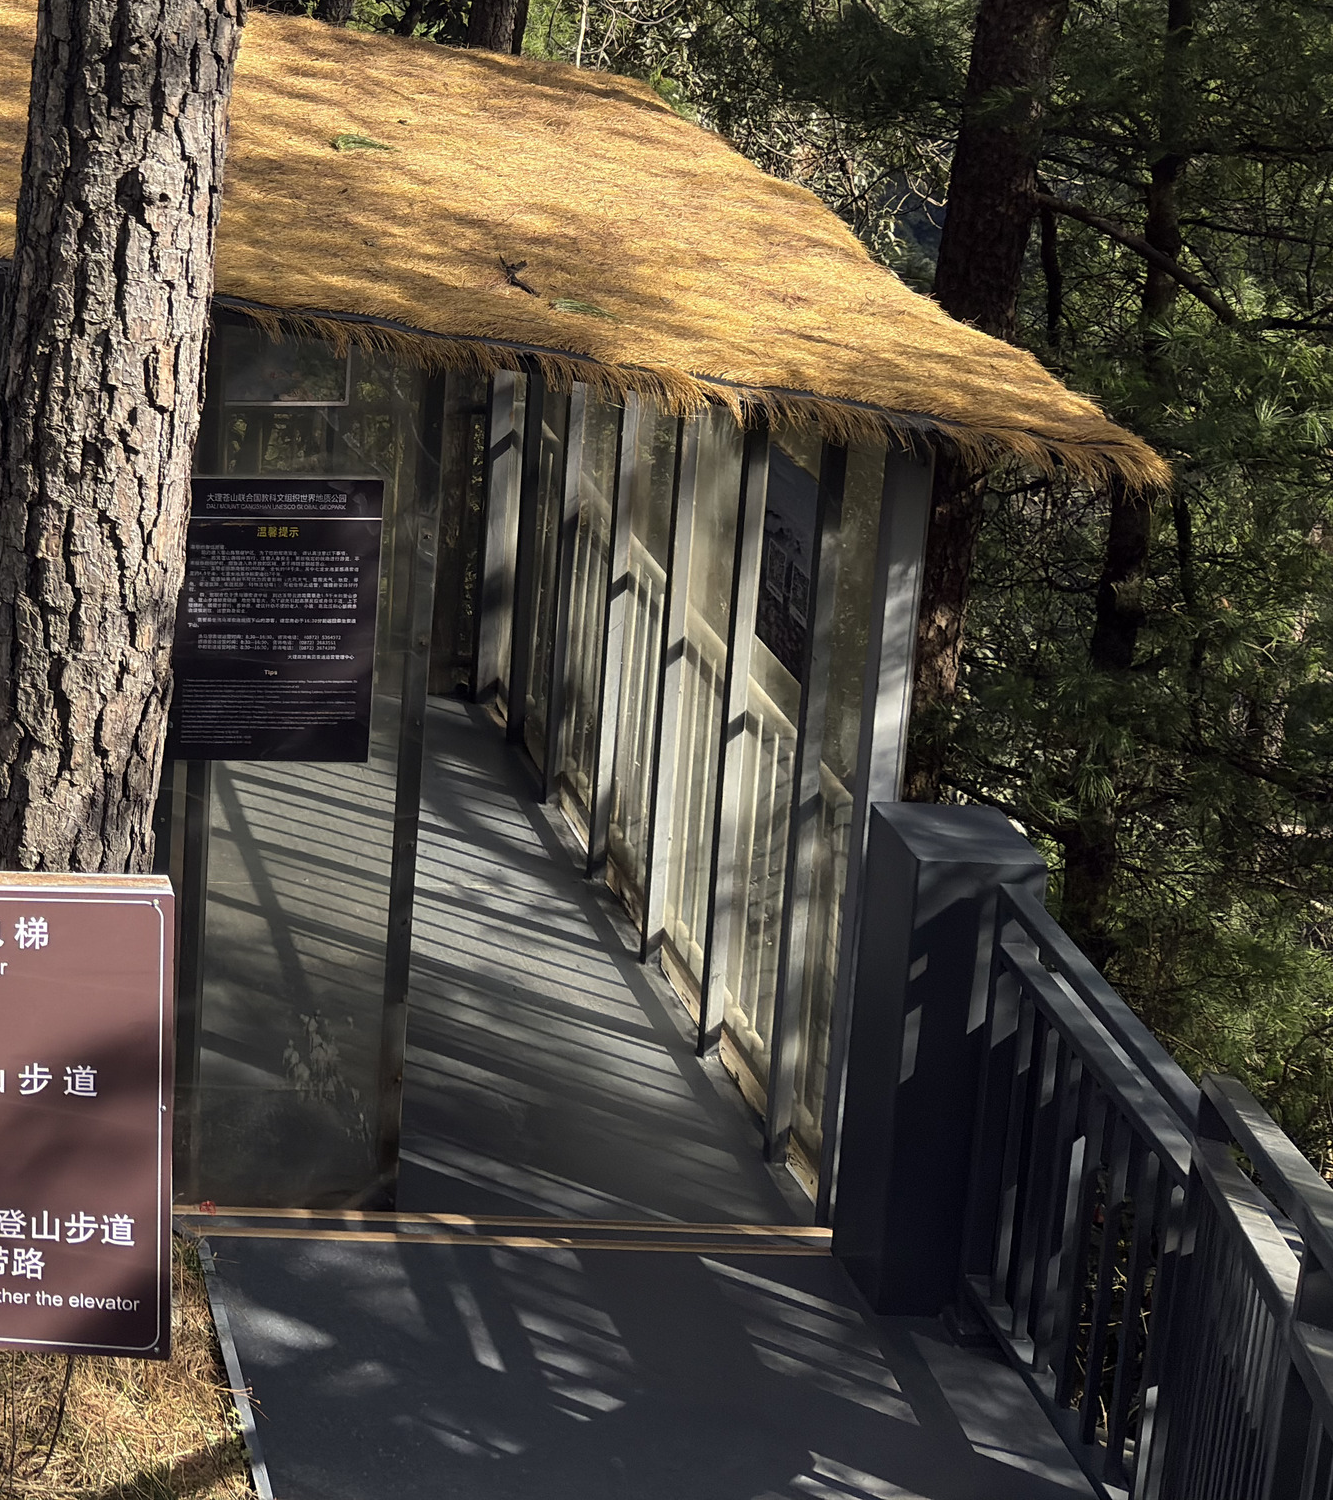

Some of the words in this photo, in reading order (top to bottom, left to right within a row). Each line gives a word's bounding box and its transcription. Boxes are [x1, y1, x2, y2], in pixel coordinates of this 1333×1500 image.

[256, 526, 300, 538] 温馨提示
[35, 1290, 63, 1307] the
[68, 1293, 140, 1312] elevator
